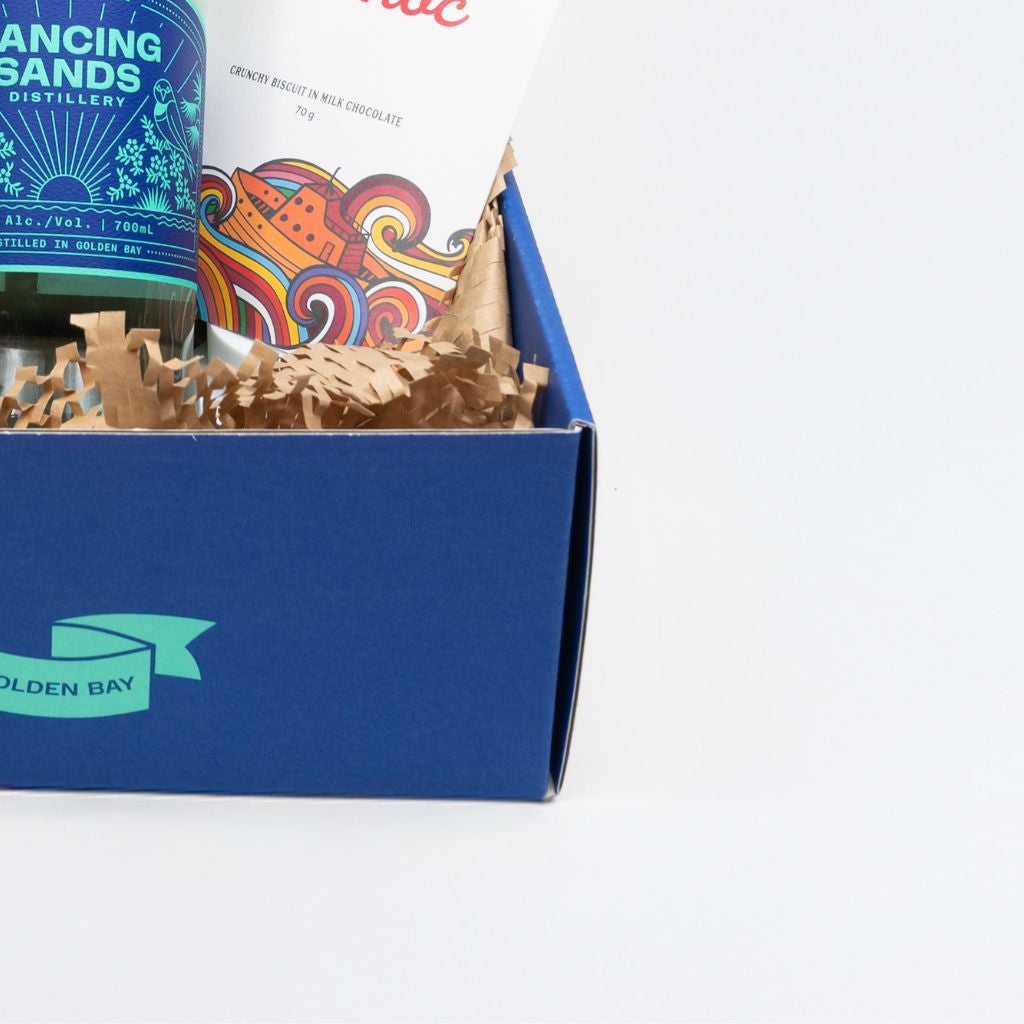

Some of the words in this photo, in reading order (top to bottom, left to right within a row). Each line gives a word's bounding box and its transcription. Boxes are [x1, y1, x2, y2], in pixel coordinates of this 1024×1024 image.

[9, 91, 126, 107] DISTILLERY
[229, 64, 270, 85] CRUNCHY
[271, 76, 308, 97] BISCUIT
[307, 88, 319, 100] IN
[320, 91, 344, 109] MILK
[345, 100, 404, 127] CHOCOLATE
[114, 220, 154, 235] 700mL
[54, 239, 69, 249] IN
[76, 240, 118, 253] GOLDEN
[124, 245, 143, 255] BAY
[87, 676, 135, 696] BAY
